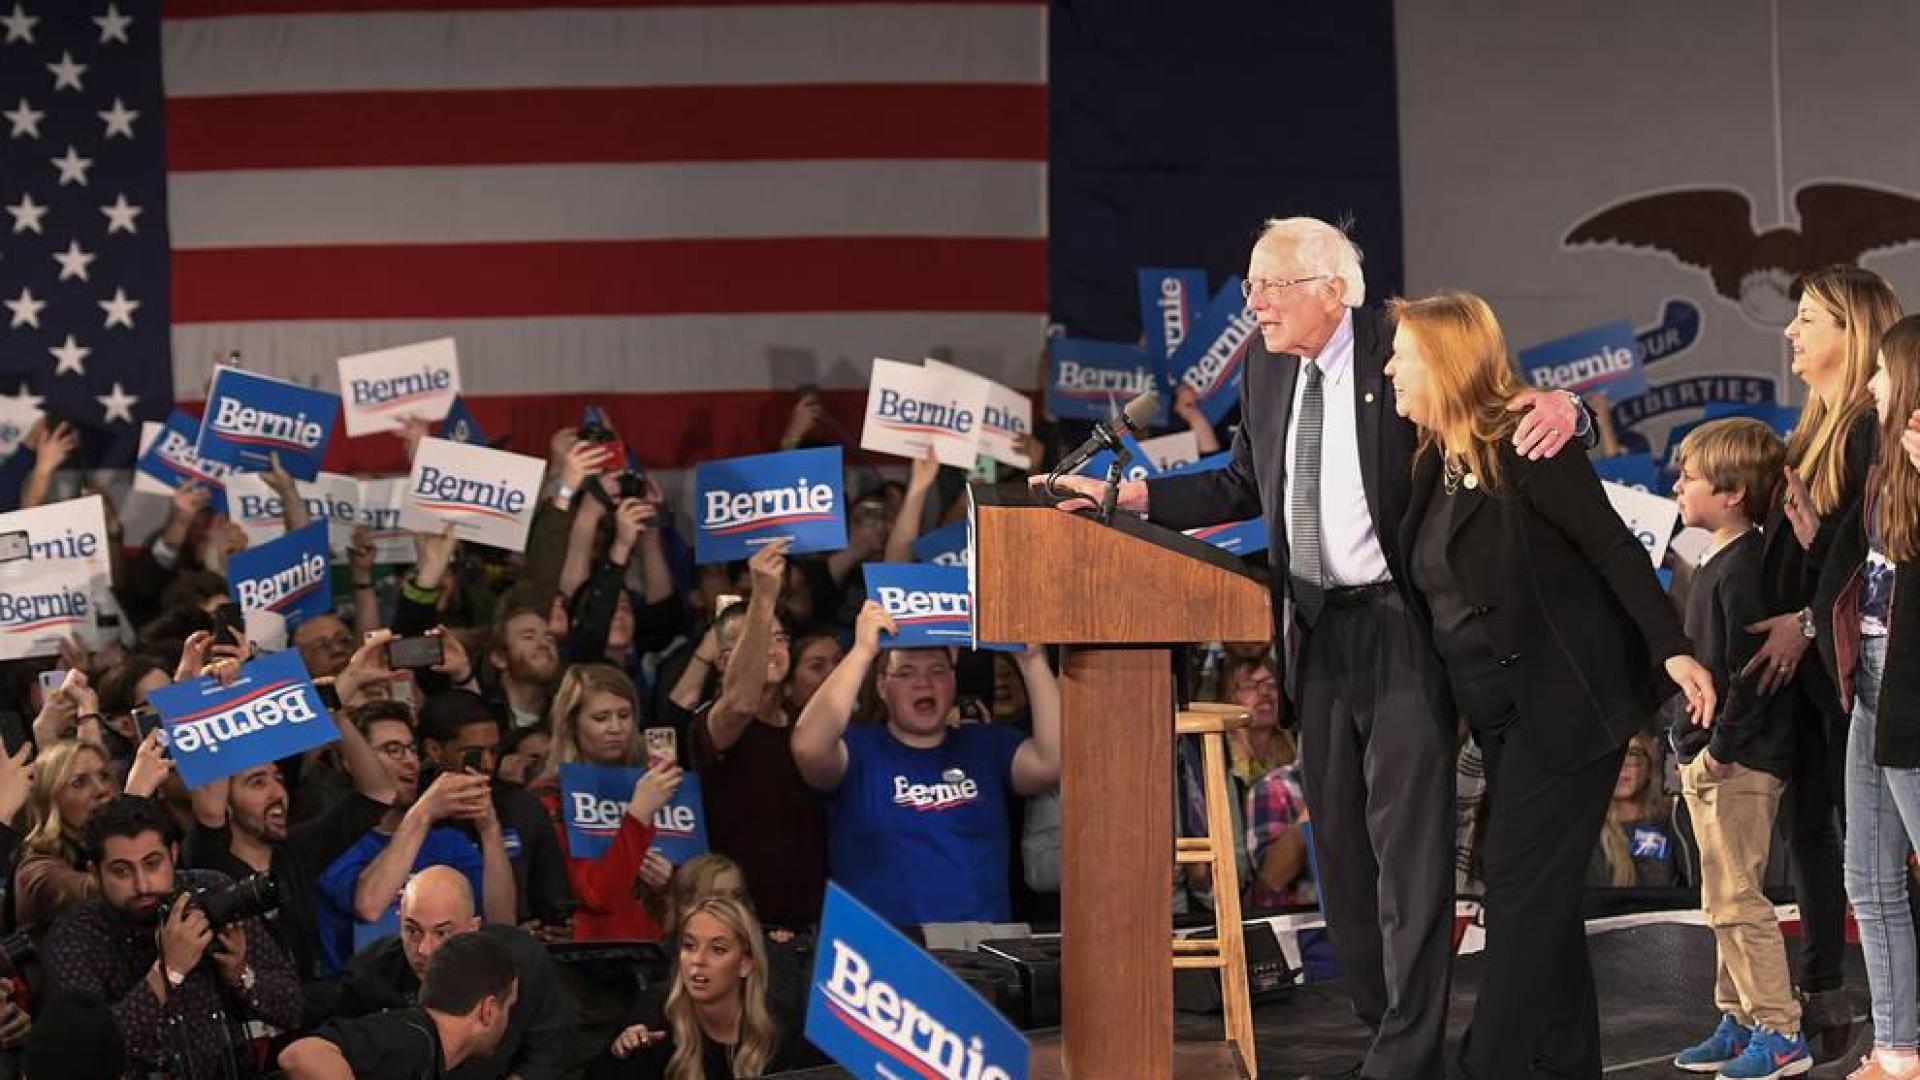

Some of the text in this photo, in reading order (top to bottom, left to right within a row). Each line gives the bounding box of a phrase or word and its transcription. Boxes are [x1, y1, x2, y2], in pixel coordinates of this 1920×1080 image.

[350, 363, 450, 405] Bernie
[1533, 346, 1633, 389] Bernie
[214, 396, 323, 449] Bernie
[877, 387, 974, 434] Bernie
[239, 493, 355, 521] Benie
[415, 465, 526, 515] Bernie
[705, 476, 833, 526] Bernie
[30, 528, 97, 561] rnie
[0, 585, 89, 622] Bernie
[236, 552, 325, 613] Bernie
[877, 586, 968, 616] Bern
[173, 688, 318, 753] Bernie
[892, 774, 979, 806] Bernie
[827, 938, 1012, 1080] Berni
